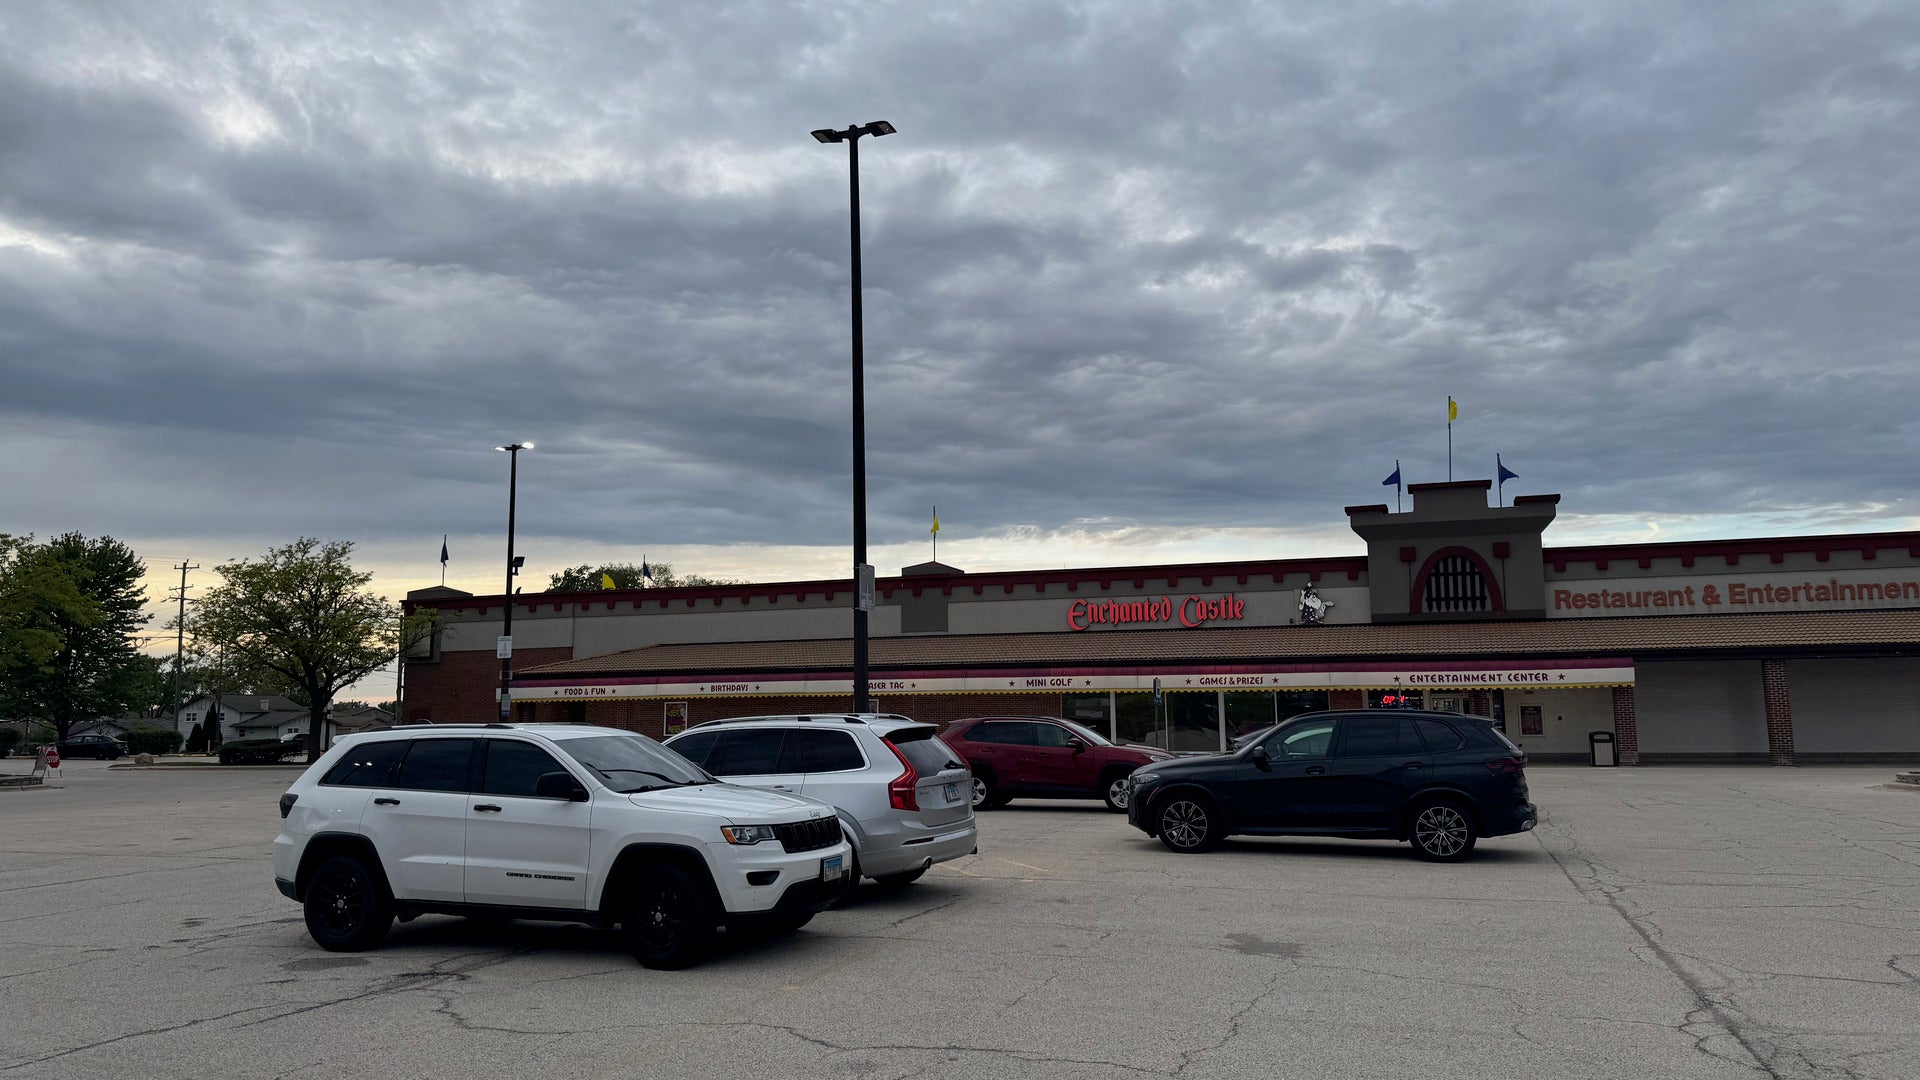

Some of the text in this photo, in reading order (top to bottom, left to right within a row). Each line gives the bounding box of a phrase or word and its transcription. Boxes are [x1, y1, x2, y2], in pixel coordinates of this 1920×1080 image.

[1554, 579, 1920, 610] Restaurant & Entertainmen
[1067, 593, 1245, 631] Enchanted Castle
[1199, 676, 1264, 685] GAMES & PRIZES
[1409, 672, 1549, 683] ENTERTAINMENT CENTER
[868, 681, 904, 690] ASER TAG
[1026, 678, 1073, 687] MINI GOLF
[564, 688, 583, 696] FOOD
[591, 687, 606, 695] FUN
[710, 683, 749, 692] BIRTHDAYS
[1382, 695, 1406, 704] OPN
